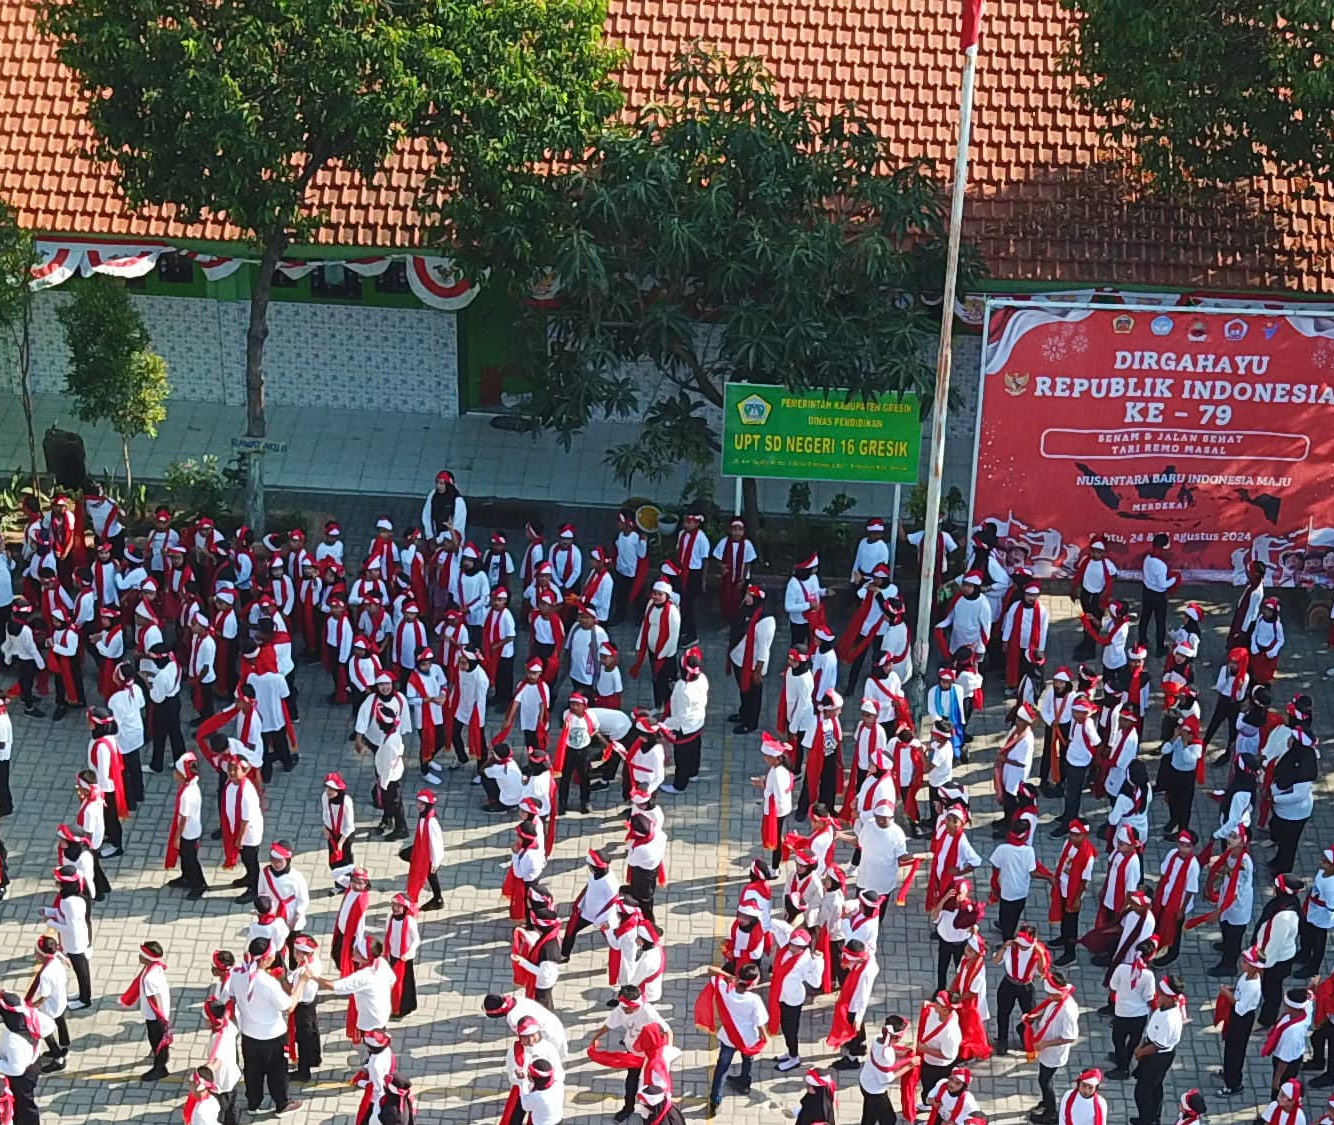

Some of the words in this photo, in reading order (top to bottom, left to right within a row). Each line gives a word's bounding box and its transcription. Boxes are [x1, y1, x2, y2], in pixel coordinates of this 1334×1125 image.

[1114, 351, 1269, 375] DIRGAHAYU
[1034, 376, 1173, 398] REPUBLIK
[781, 398, 832, 410] PEMERINTAH
[882, 403, 912, 413] GRESIK
[1124, 402, 1164, 423] KE
[1199, 405, 1232, 425] 79
[808, 416, 833, 426] DINAS
[834, 417, 883, 428] PENDIDIKAN
[734, 433, 761, 451] UPT
[764, 435, 782, 452] SD
[786, 436, 835, 454] NEGERI
[841, 439, 855, 456] 16
[859, 439, 908, 457] GRESIK
[1098, 432, 1140, 443] SENAM
[1157, 432, 1198, 443] JALAN
[1202, 434, 1243, 444] SEHAT
[1112, 445, 1141, 455] TARI
[1144, 444, 1179, 453] REMO
[1185, 445, 1227, 455] MASAL
[1076, 475, 1151, 486] NUSANTARA
[1153, 473, 1185, 483] BARU
[1188, 474, 1254, 486] INDONESIA
[1256, 476, 1292, 487] MAJU
[1129, 532, 1143, 543] 24
[1173, 532, 1219, 543] agustus
[1221, 531, 1252, 542] 2024
